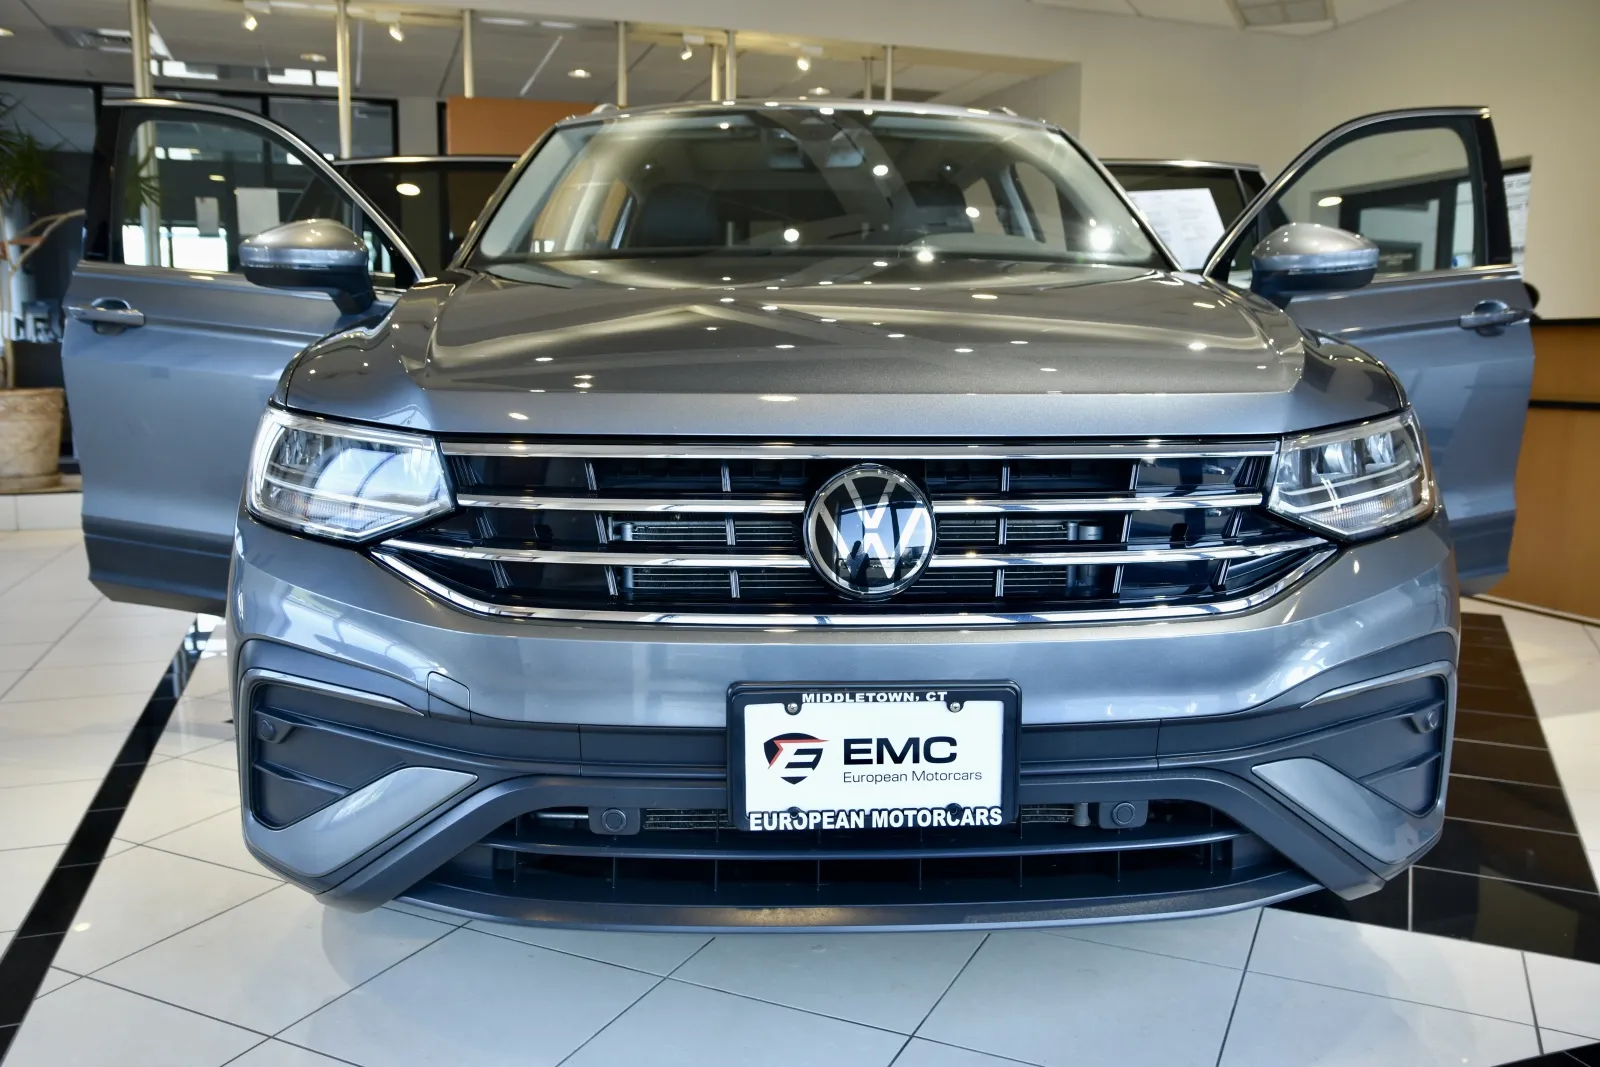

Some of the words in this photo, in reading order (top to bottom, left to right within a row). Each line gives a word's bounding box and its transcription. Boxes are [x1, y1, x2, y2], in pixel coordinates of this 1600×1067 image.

[802, 691, 920, 703] MIDDLETOWN,
[926, 691, 948, 702] CT
[843, 736, 958, 765] EMC
[843, 771, 908, 784] European
[912, 770, 983, 782] Motorcars
[749, 810, 865, 831] EUROPEAN
[871, 807, 1003, 828] MOTORCARS
